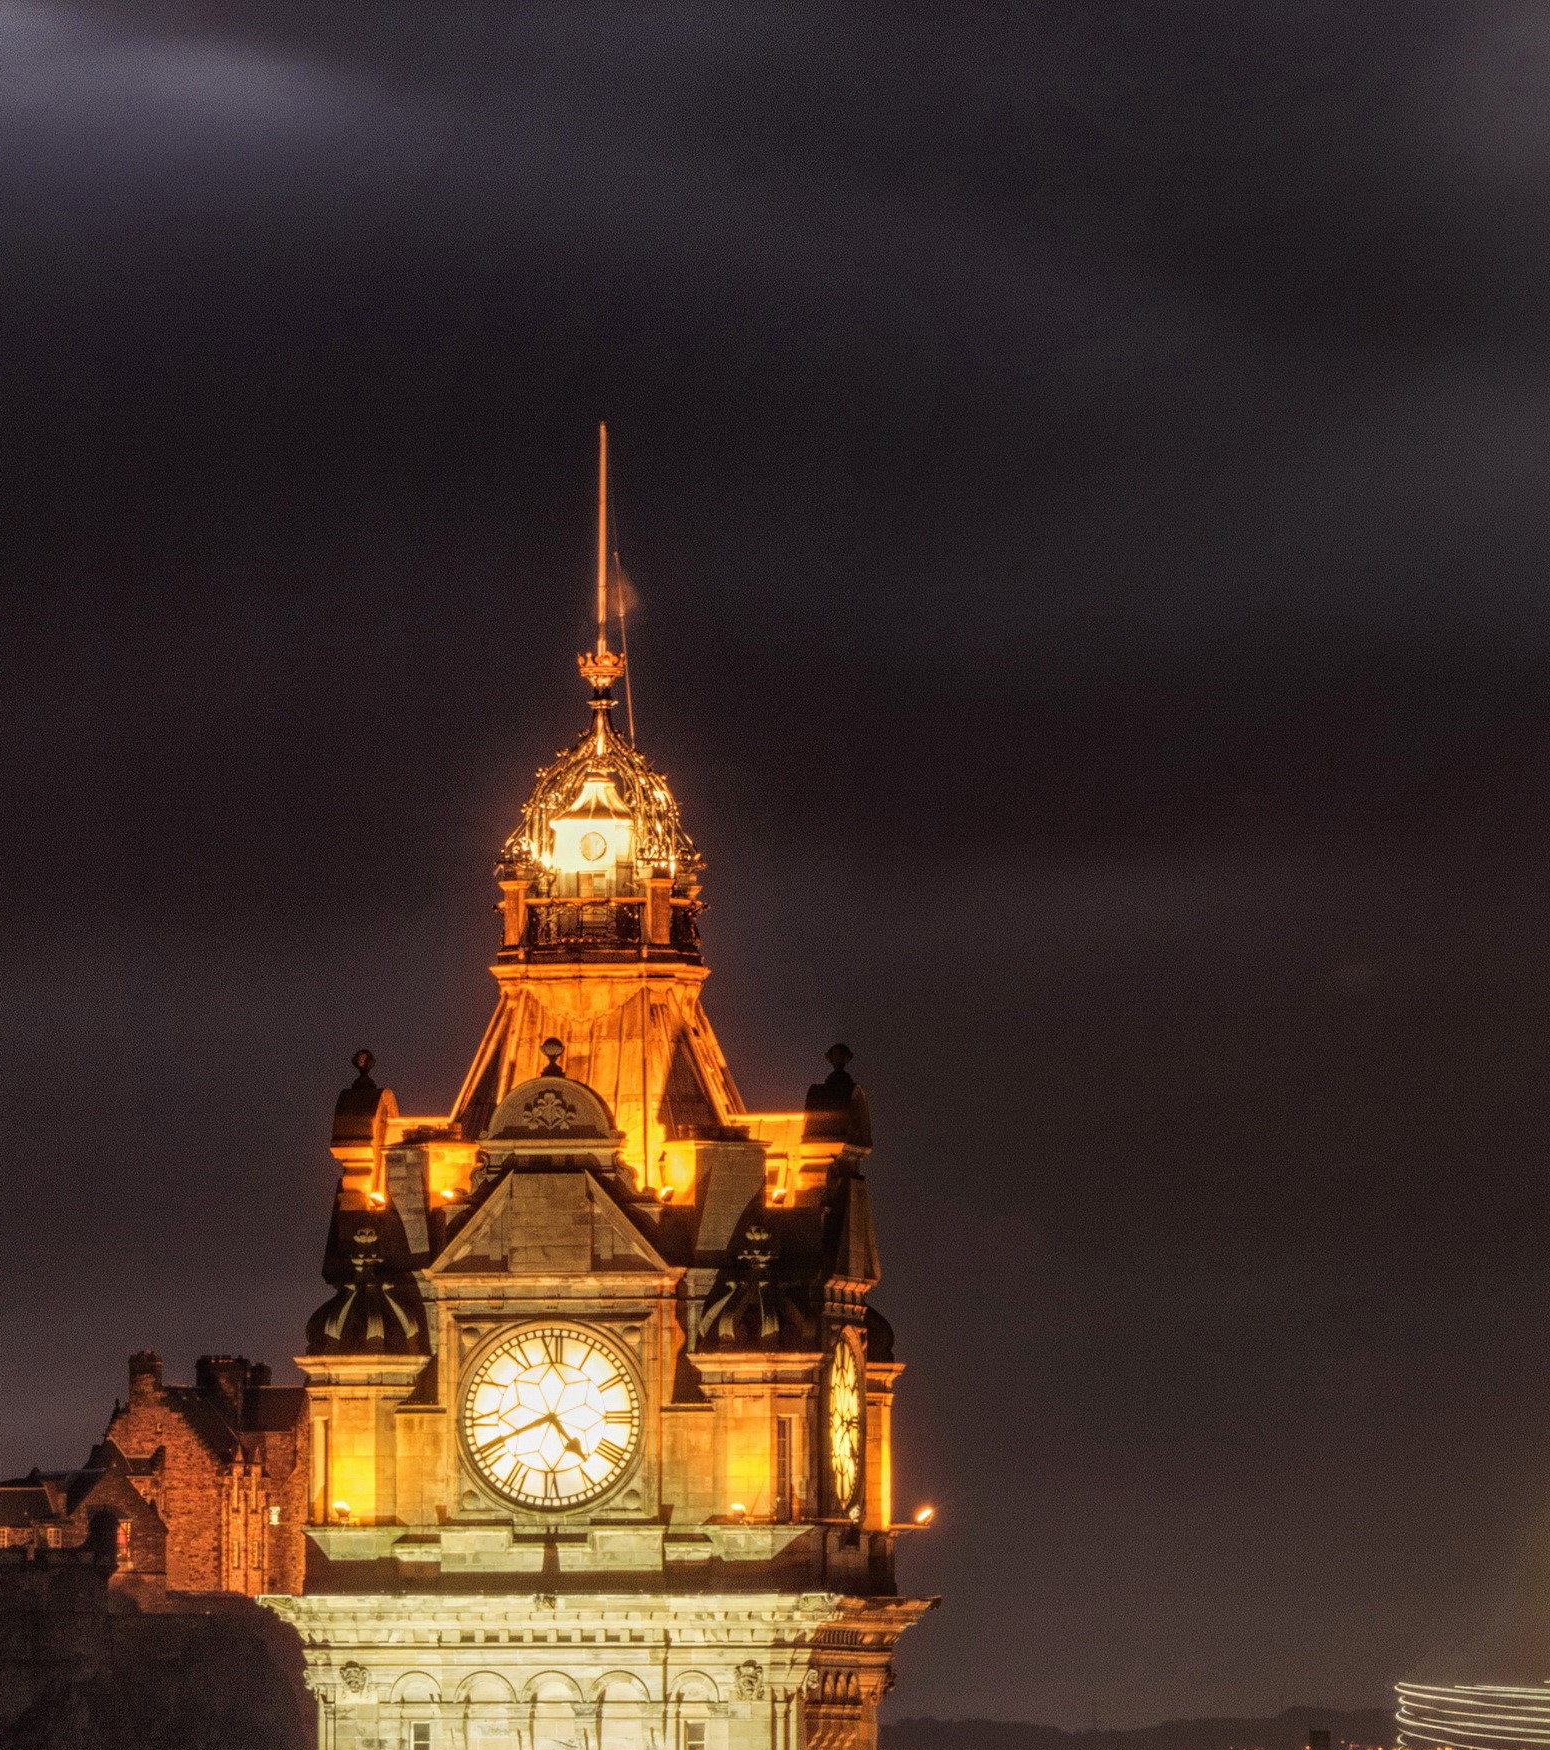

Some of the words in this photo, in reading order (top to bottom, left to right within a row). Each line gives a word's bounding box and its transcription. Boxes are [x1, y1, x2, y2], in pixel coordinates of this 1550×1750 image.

[541, 1336, 563, 1364] XII
[579, 1345, 594, 1370] I
[597, 1374, 623, 1393] II
[605, 1411, 632, 1424] III
